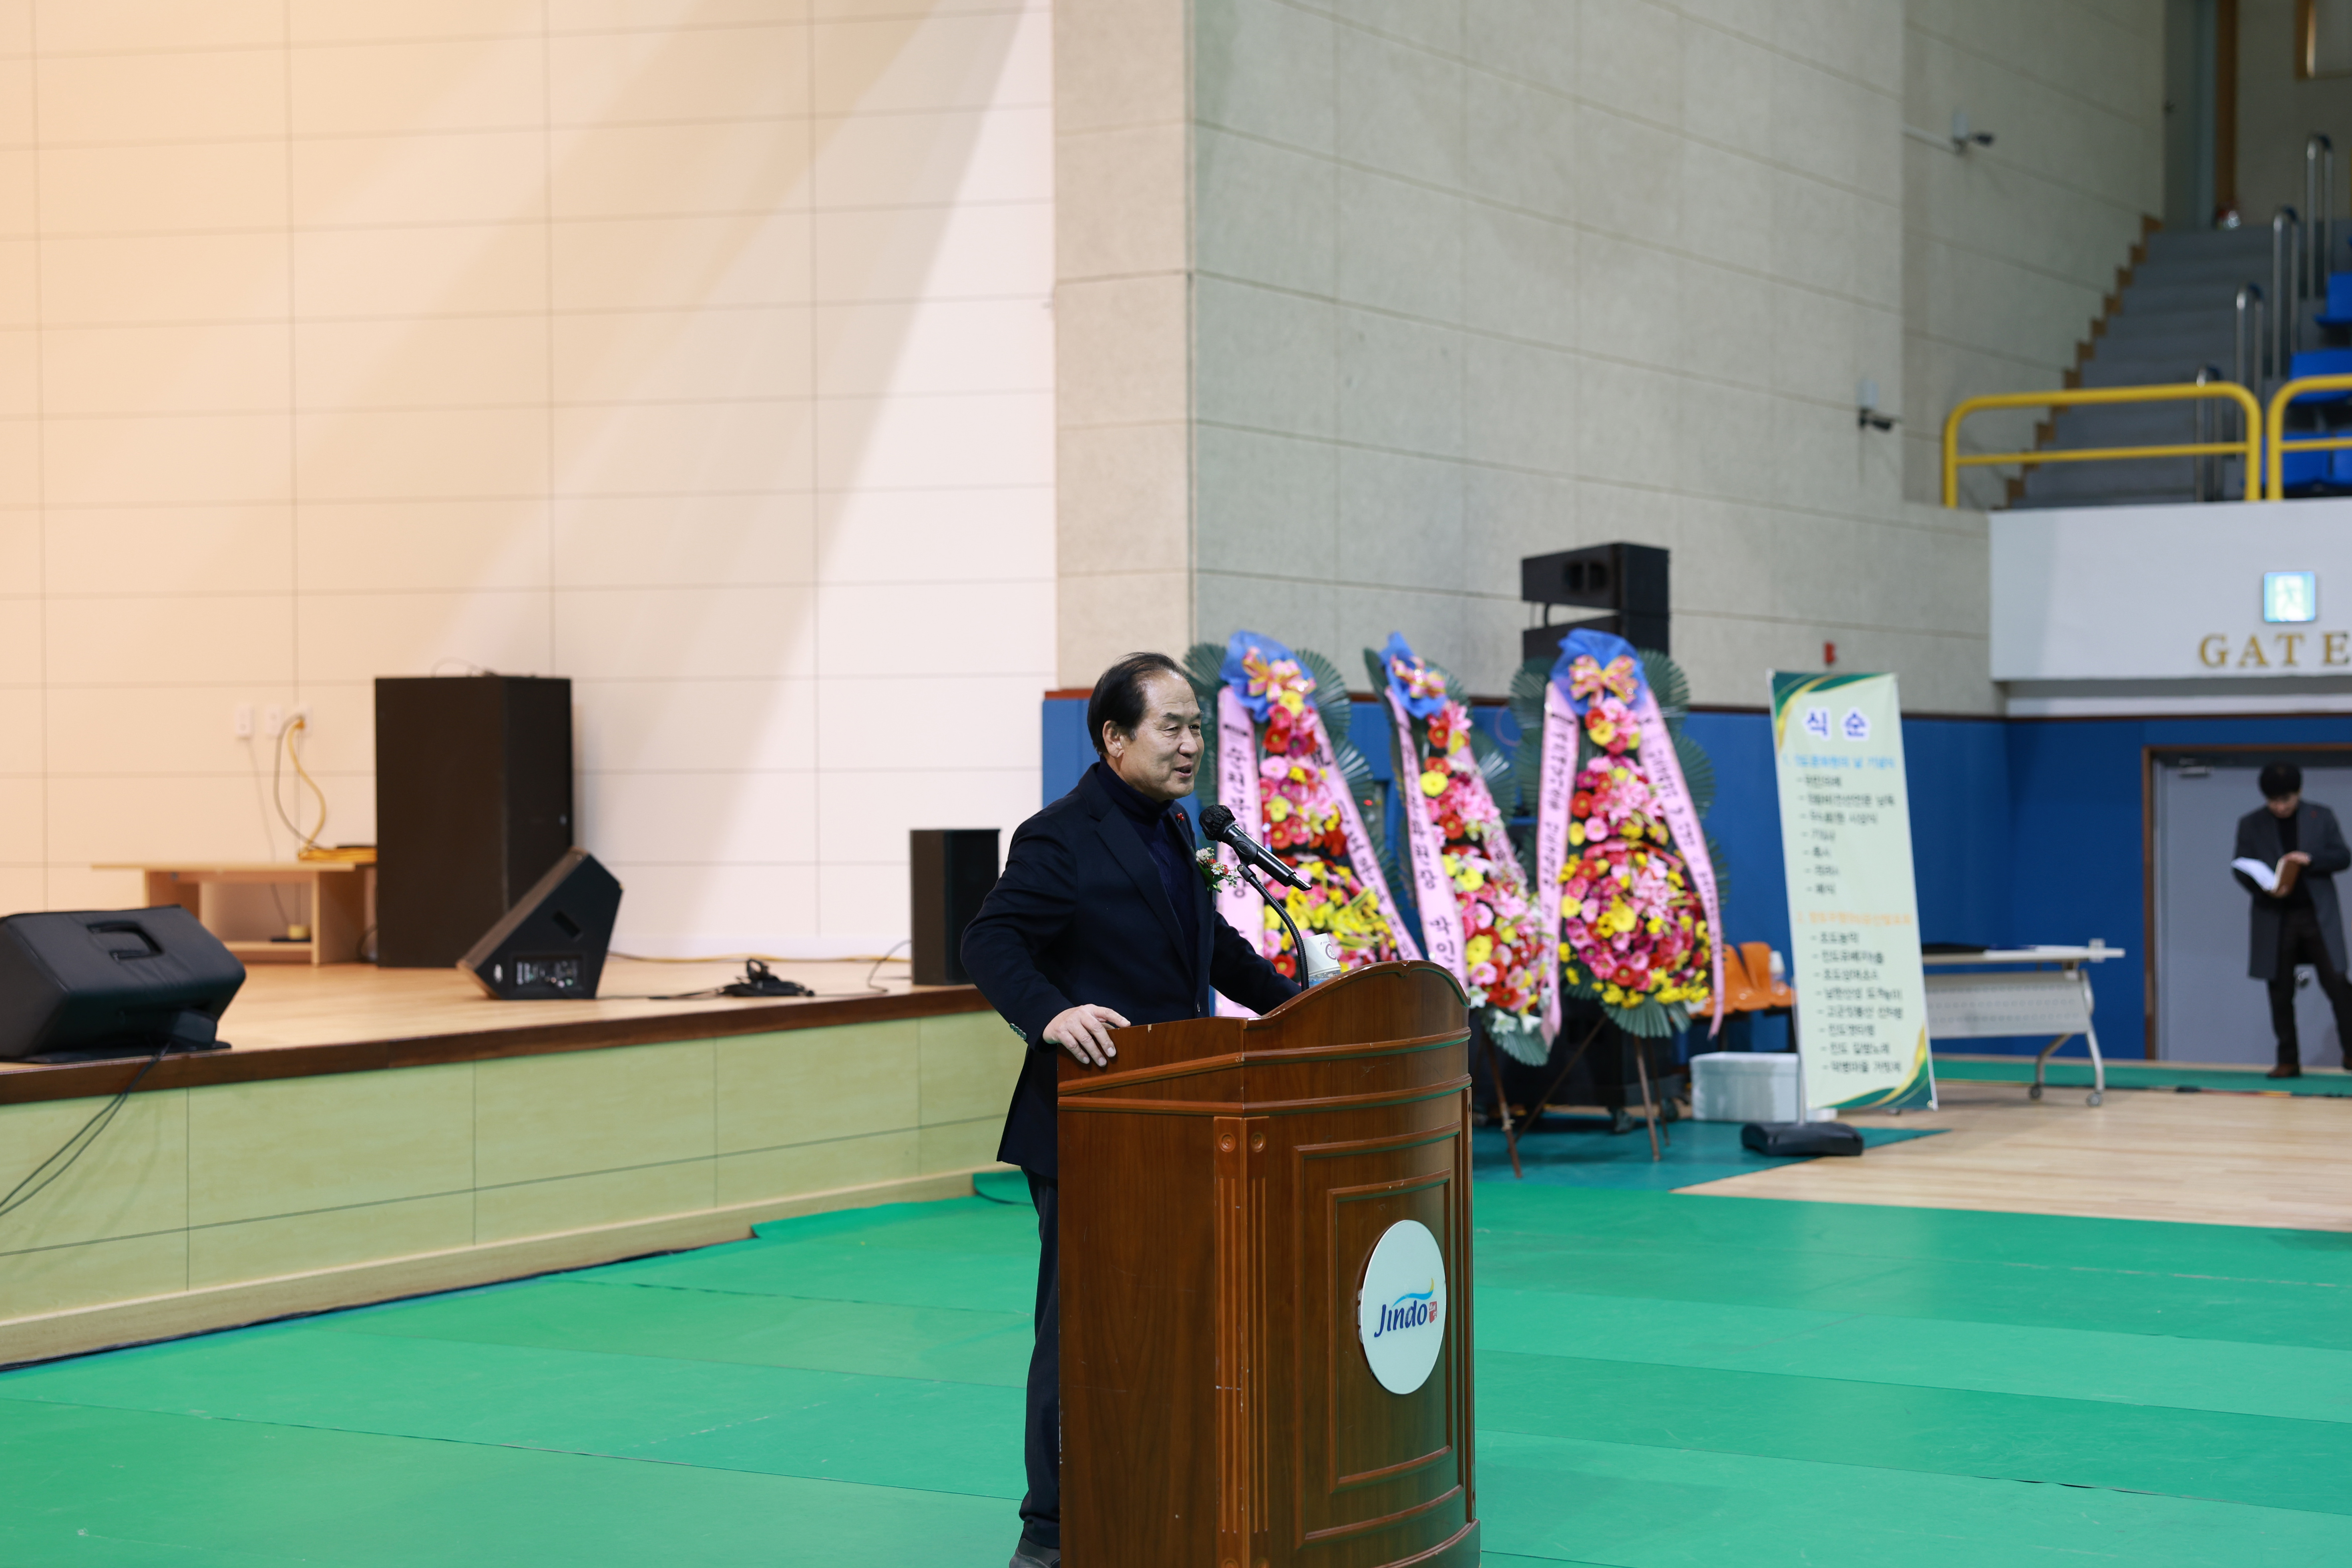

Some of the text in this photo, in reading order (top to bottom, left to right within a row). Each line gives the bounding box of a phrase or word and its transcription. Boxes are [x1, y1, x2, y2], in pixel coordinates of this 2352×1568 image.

[2199, 631, 2350, 667] GATE
[1807, 712, 1866, 737] 식 순
[1374, 1300, 1427, 1338] Jindo
